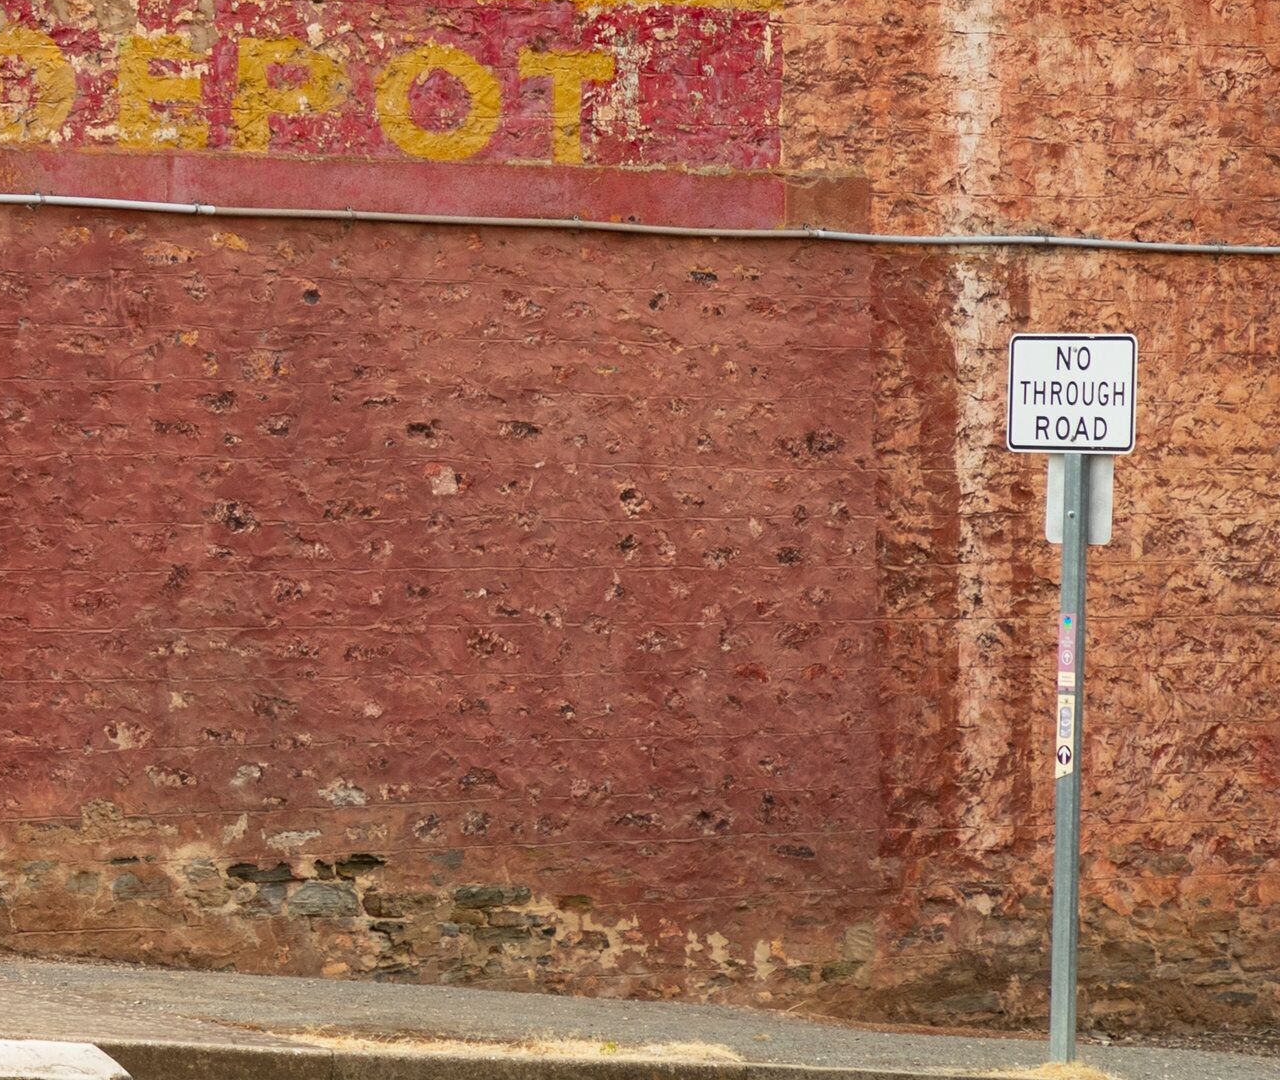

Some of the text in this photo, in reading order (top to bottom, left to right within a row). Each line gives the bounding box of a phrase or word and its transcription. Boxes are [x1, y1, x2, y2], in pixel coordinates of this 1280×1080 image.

[1056, 346, 1091, 371] NO
[1020, 381, 1126, 407] THROUGH
[1035, 416, 1108, 441] ROAD
